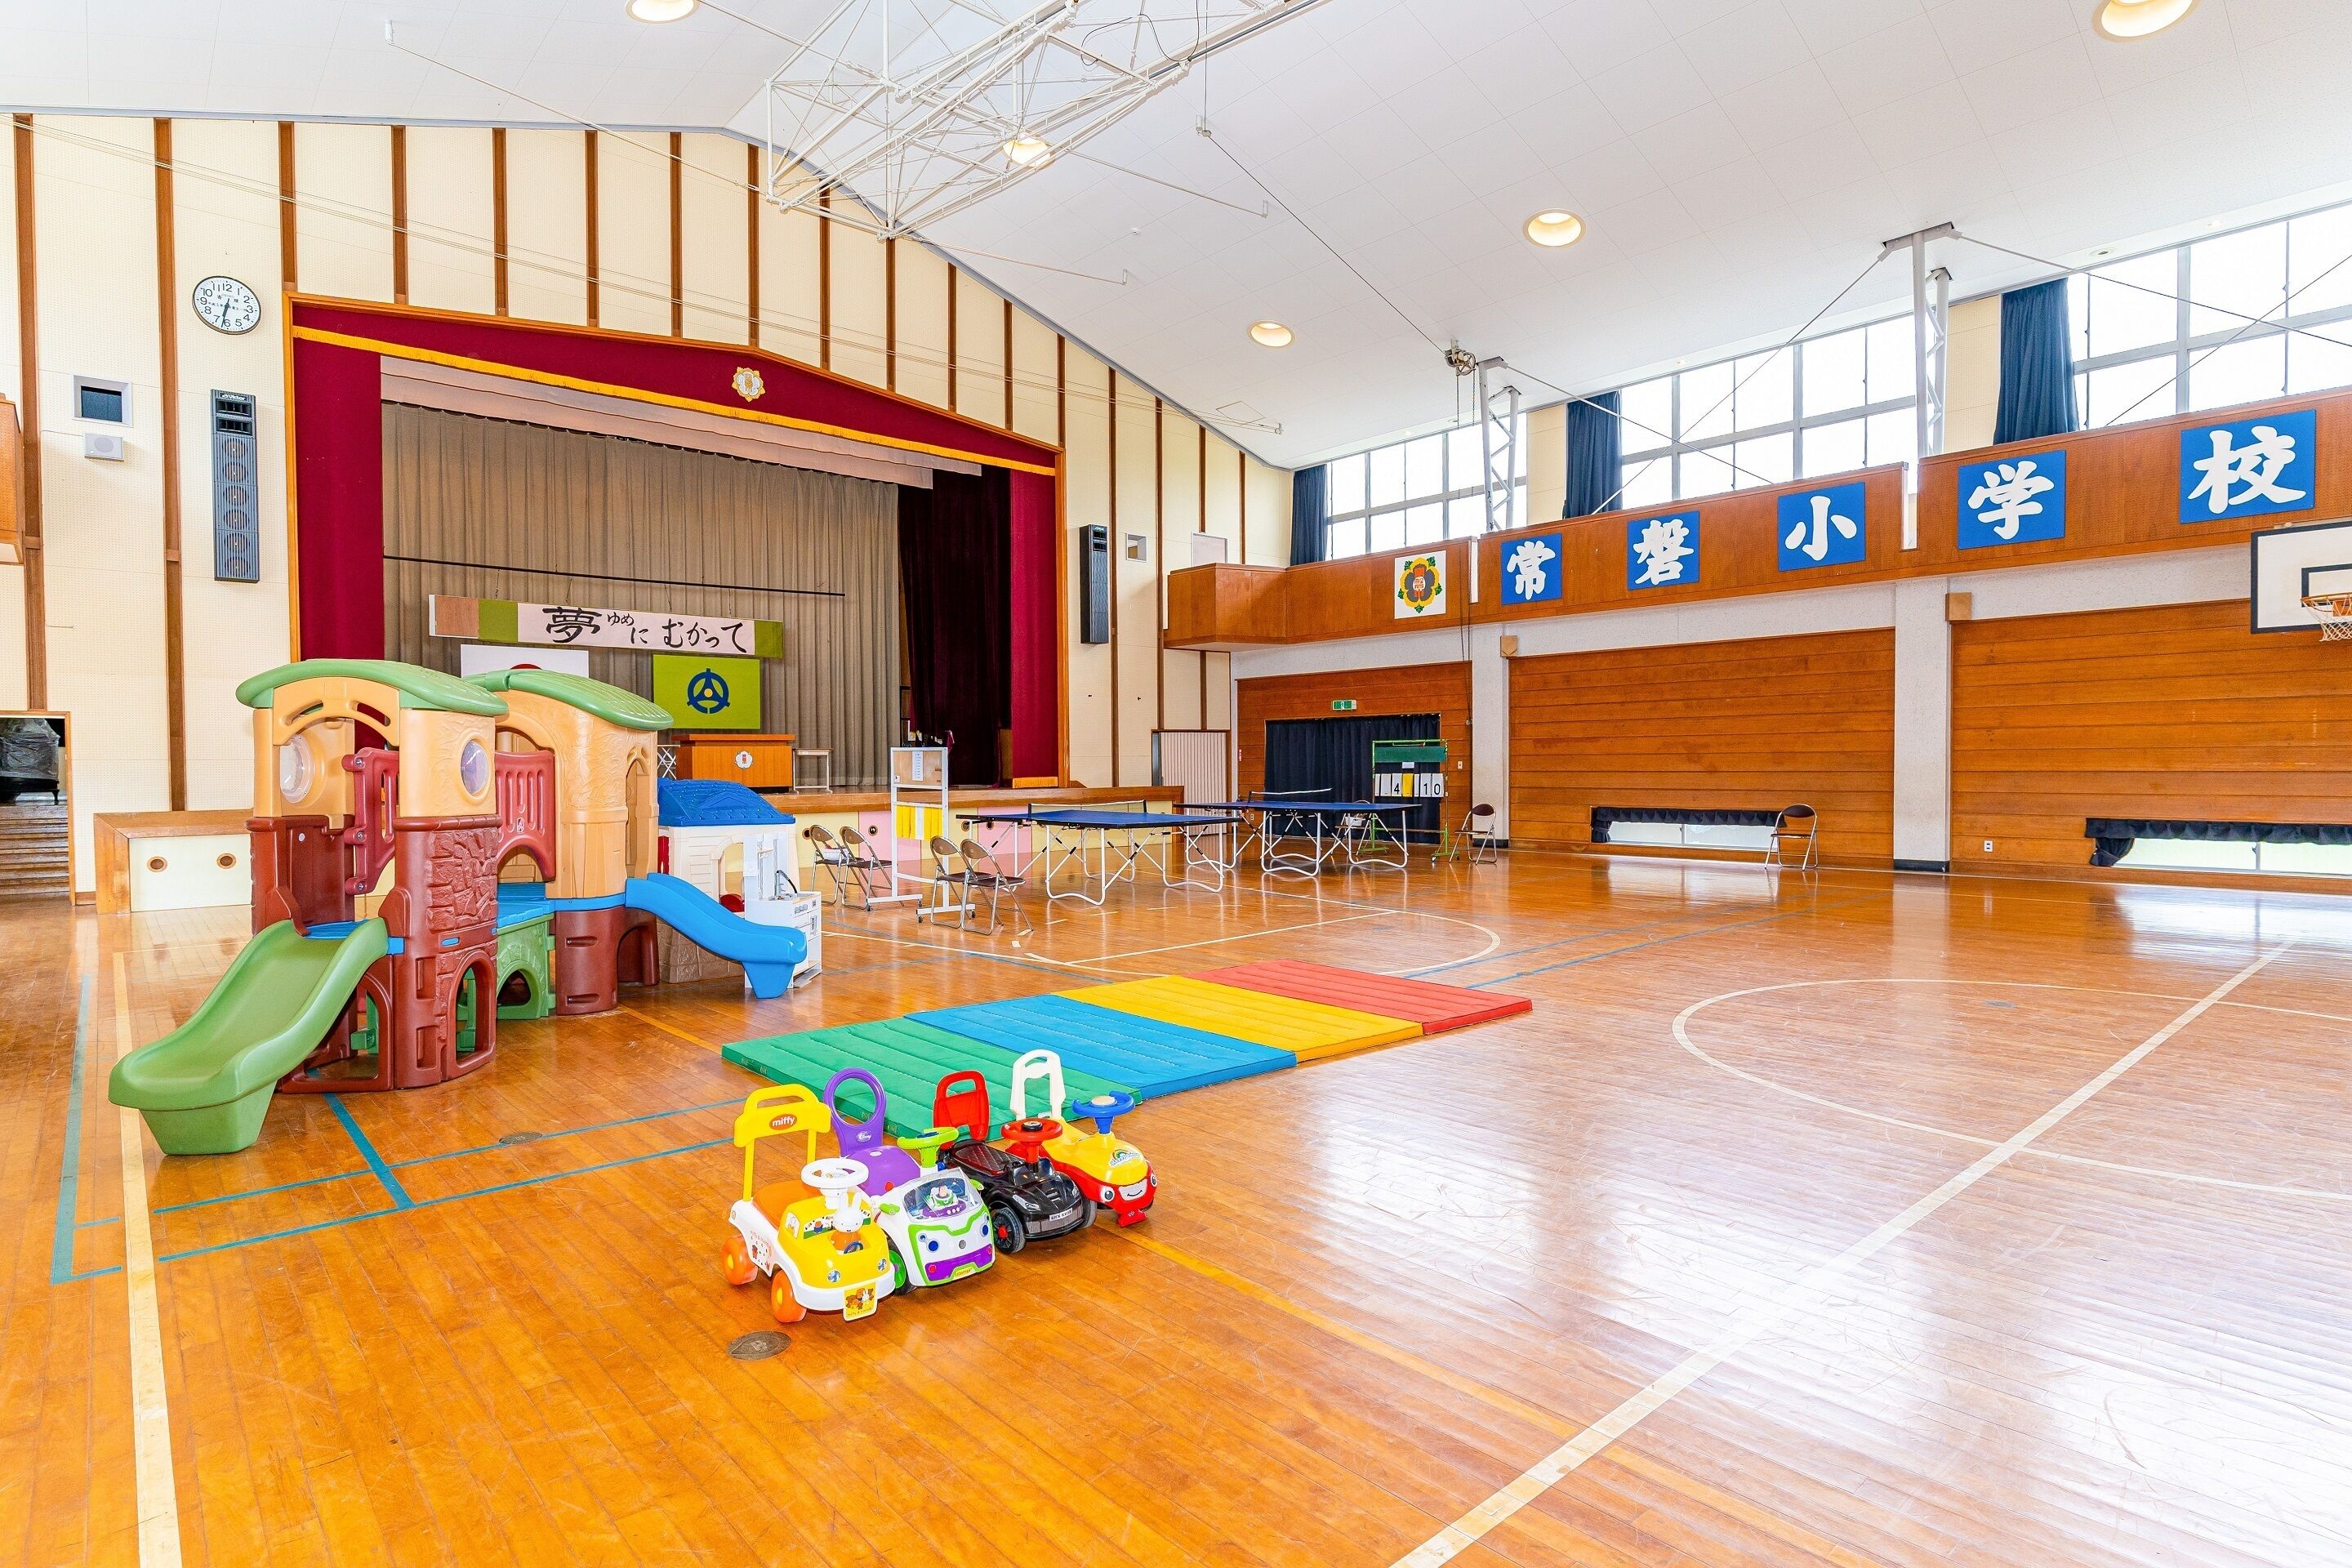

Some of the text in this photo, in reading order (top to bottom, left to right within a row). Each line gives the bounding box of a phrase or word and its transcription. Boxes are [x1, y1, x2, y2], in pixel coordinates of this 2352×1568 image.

[213, 283, 220, 292] 11
[223, 283, 233, 292] 12
[203, 288, 213, 297] 10
[200, 296, 207, 305] 9
[243, 296, 251, 304] 2
[204, 306, 212, 314] 8
[246, 305, 254, 314] 3
[213, 314, 220, 323] 7
[235, 318, 243, 327] 5
[1393, 782, 1400, 795] 4
[772, 1116, 795, 1127] miffy
